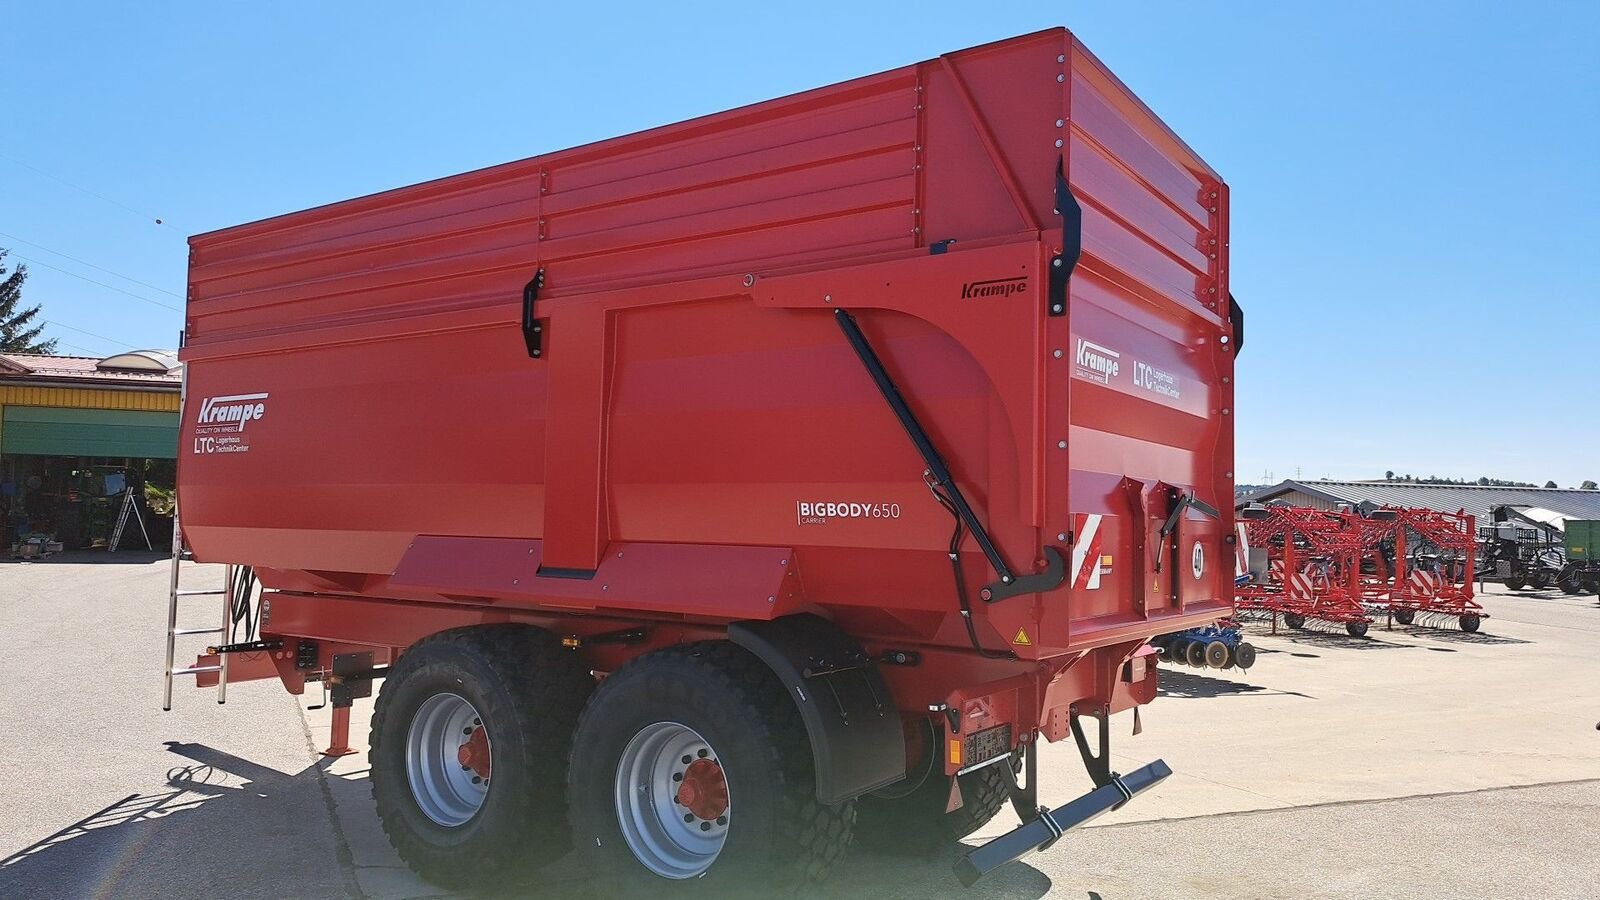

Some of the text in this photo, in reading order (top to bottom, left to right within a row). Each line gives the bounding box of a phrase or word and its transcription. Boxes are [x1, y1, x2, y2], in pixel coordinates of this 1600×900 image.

[961, 276, 1028, 299] Krampe
[1076, 338, 1120, 385] Krampe
[1133, 360, 1153, 390] LTC
[197, 392, 269, 432] Krampe
[215, 436, 241, 445] Lagerhaus
[221, 425, 239, 433] WHEELS
[194, 436, 215, 454] LTC
[215, 445, 249, 453] TechnikCenter
[1194, 548, 1202, 572] 40
